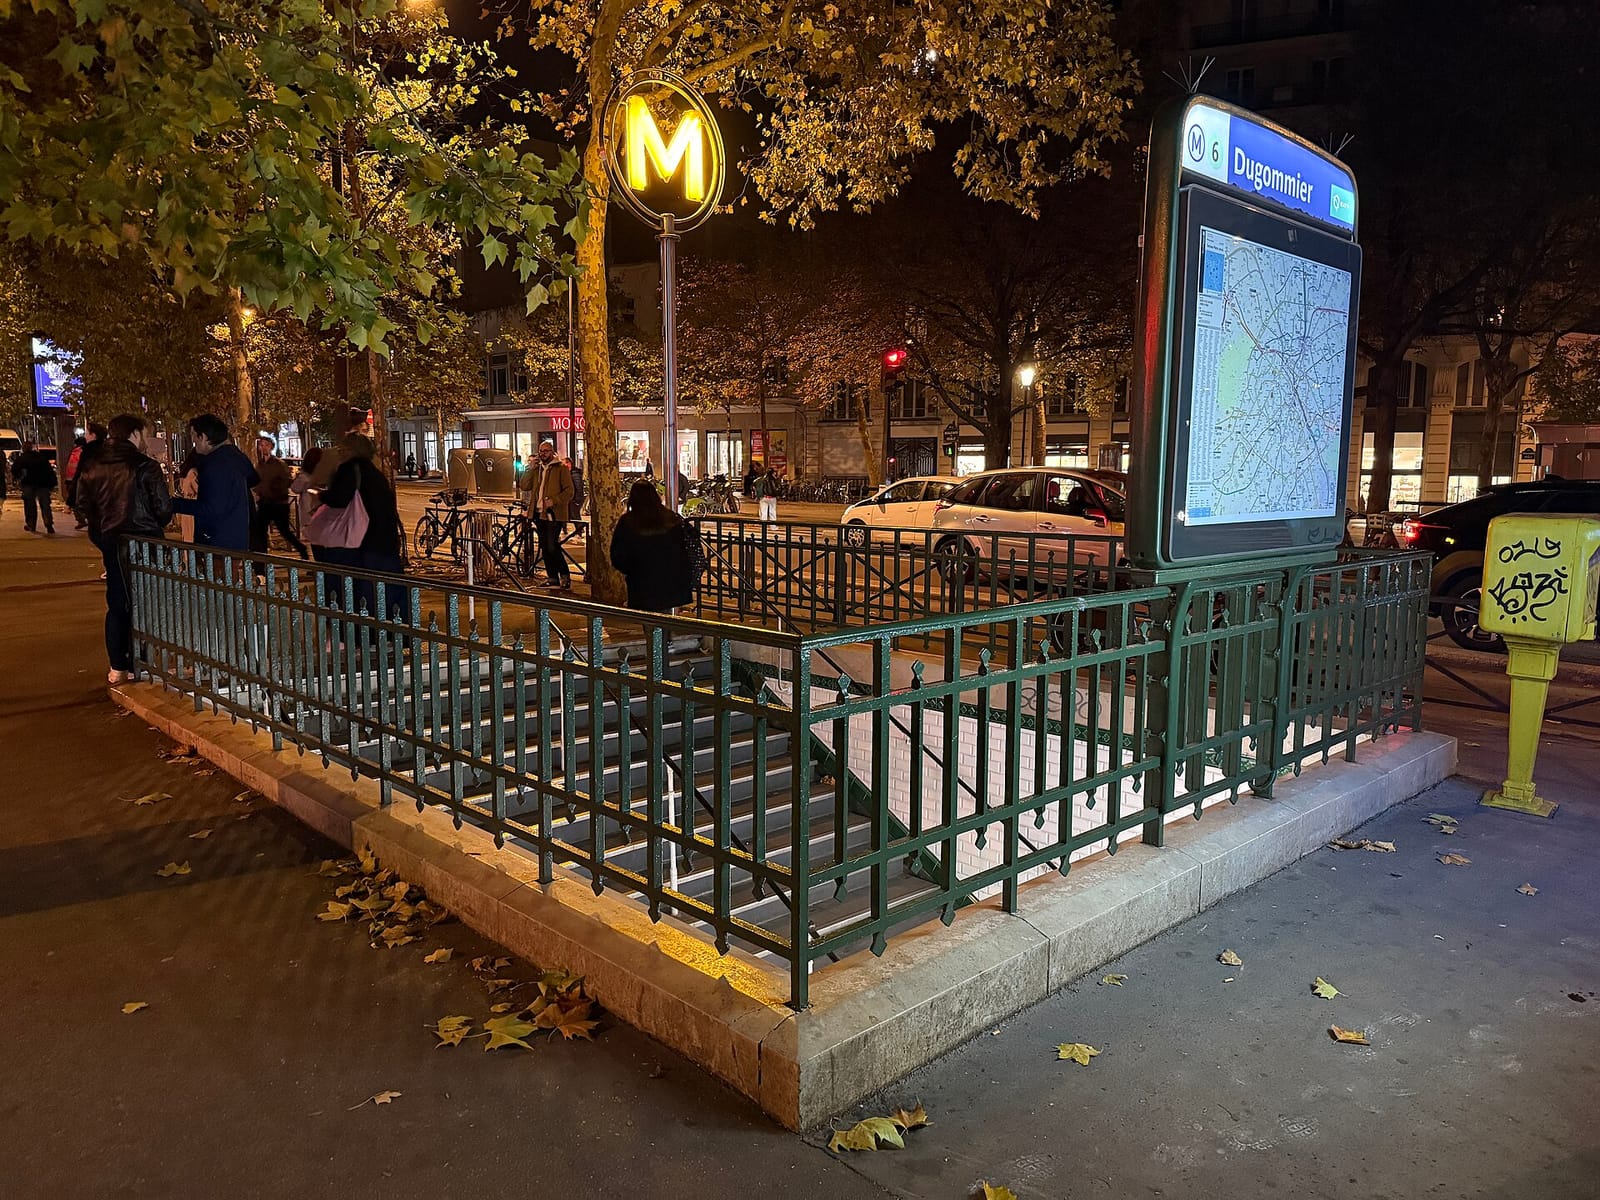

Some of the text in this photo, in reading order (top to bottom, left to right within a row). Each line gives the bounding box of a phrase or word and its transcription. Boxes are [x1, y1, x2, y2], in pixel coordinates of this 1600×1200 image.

[626, 95, 704, 202] M
[1212, 141, 1219, 162] 6
[1234, 147, 1314, 203] Dugommier
